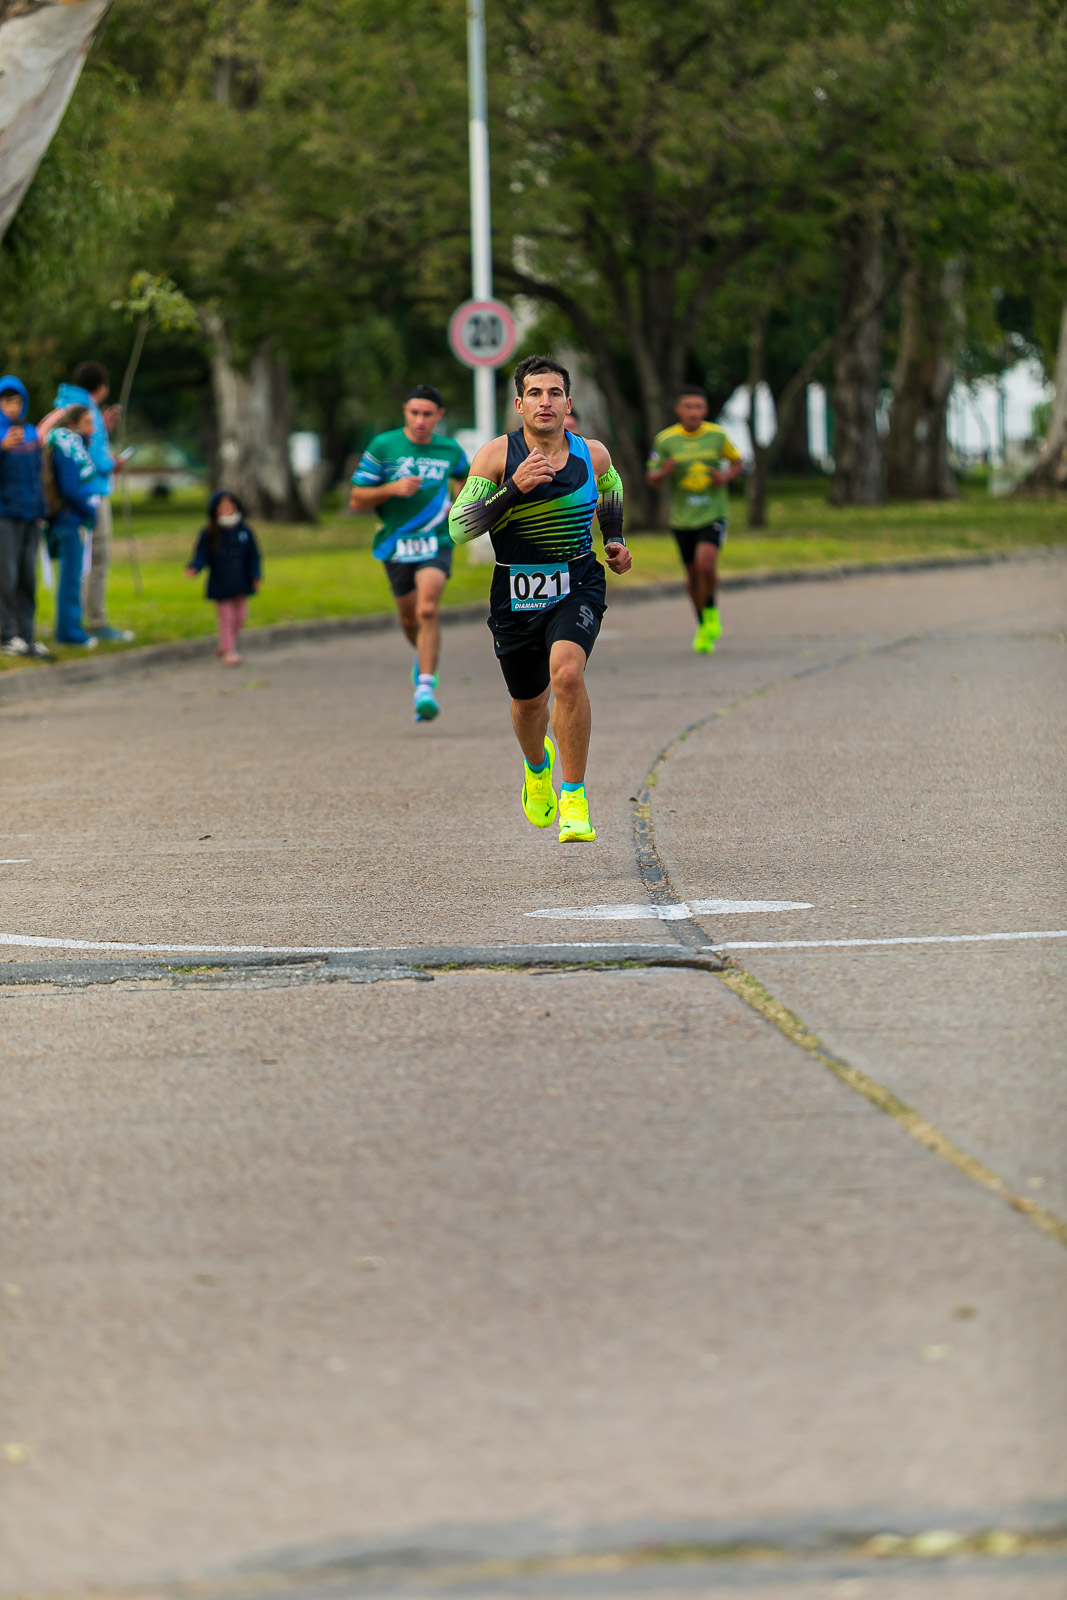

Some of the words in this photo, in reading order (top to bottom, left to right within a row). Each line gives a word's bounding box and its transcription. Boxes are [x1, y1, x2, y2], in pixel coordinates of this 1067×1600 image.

[469, 315, 503, 348] 20
[514, 570, 562, 601] 021
[514, 602, 546, 610] DIAMANTE
